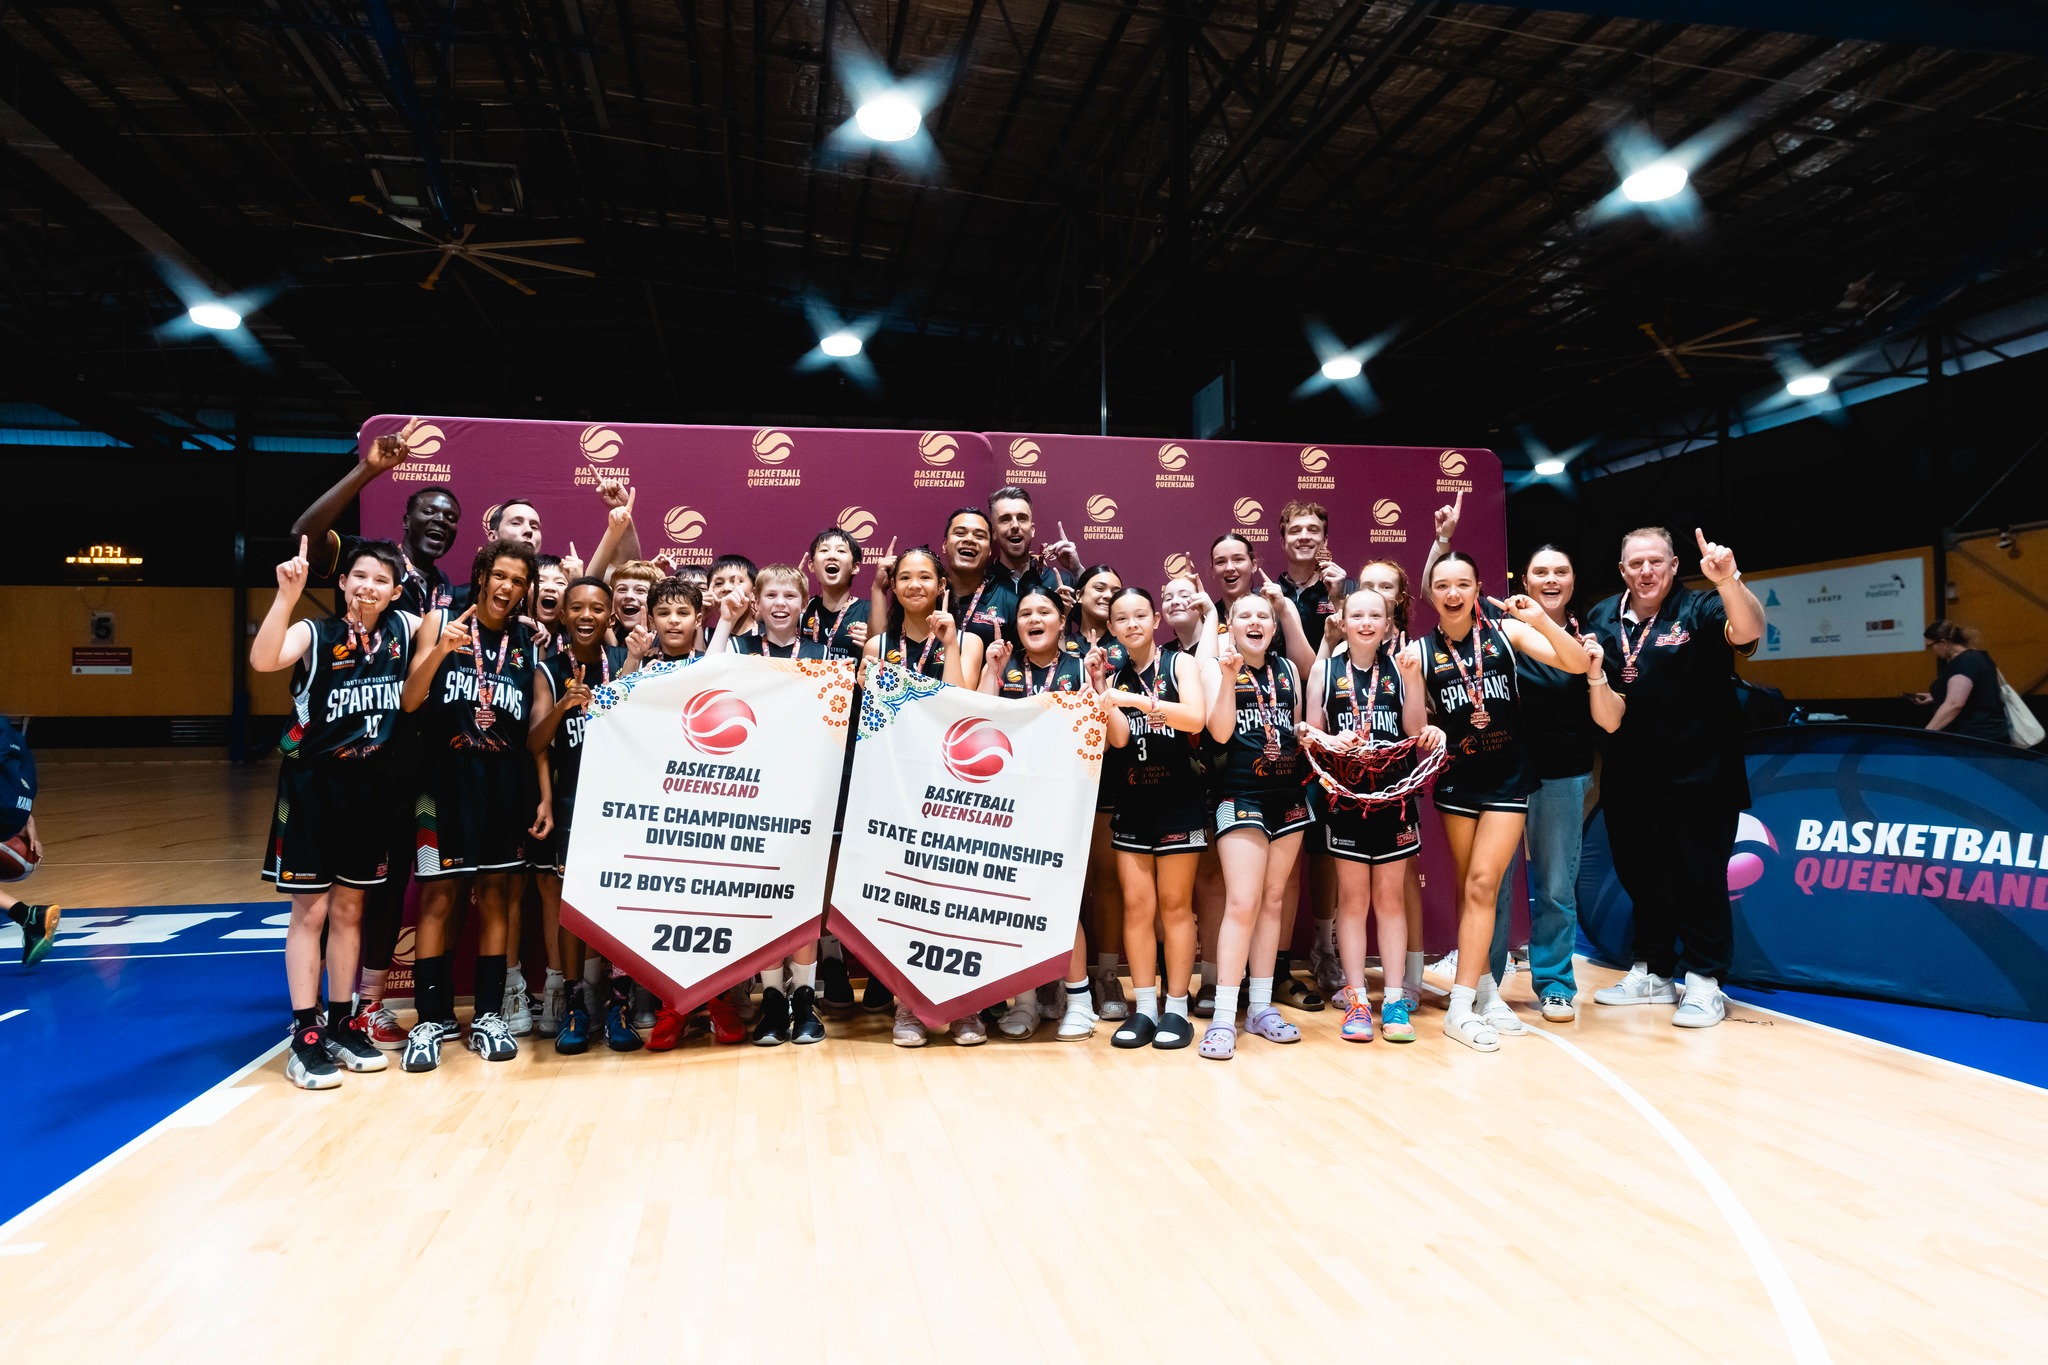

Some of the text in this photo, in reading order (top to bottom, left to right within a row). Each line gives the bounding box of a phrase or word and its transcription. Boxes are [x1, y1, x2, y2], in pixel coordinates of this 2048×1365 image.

[392, 463, 451, 473] BASKETBALL
[392, 472, 451, 482] QUEENSLAND
[747, 469, 801, 478] BASKETBALL
[913, 470, 965, 479] BASKETBALL
[1005, 470, 1047, 478] BASKETBALL
[1155, 474, 1195, 482] BASKETBALL
[747, 478, 801, 488] QUEENSLAND
[913, 479, 965, 488] QUEENSLAND
[1005, 477, 1047, 485] QUEENSLAND
[660, 548, 713, 556] BASKETBALL
[364, 714, 383, 739] 10
[1136, 737, 1148, 762] 3
[666, 760, 761, 783] BASKETBALL
[662, 777, 759, 799] QUEENSLAND
[925, 785, 1015, 814] BASKETBALL
[602, 801, 812, 835] STATE CHAMPIONSHIPS
[921, 802, 1013, 828] QUEENSLAND
[646, 827, 765, 853] DIVISION ONE
[868, 819, 1064, 868] STATE CHAMPIONSHIPS
[904, 850, 1017, 882] DIVISION ONE
[600, 871, 795, 900] U12 BOYS CHAMPIONS
[1794, 857, 2048, 911] QUEENSLAND
[862, 883, 1047, 932] U12 GIRLS CHAMPIONS
[652, 924, 733, 954] 2026
[907, 940, 983, 978] 2026
